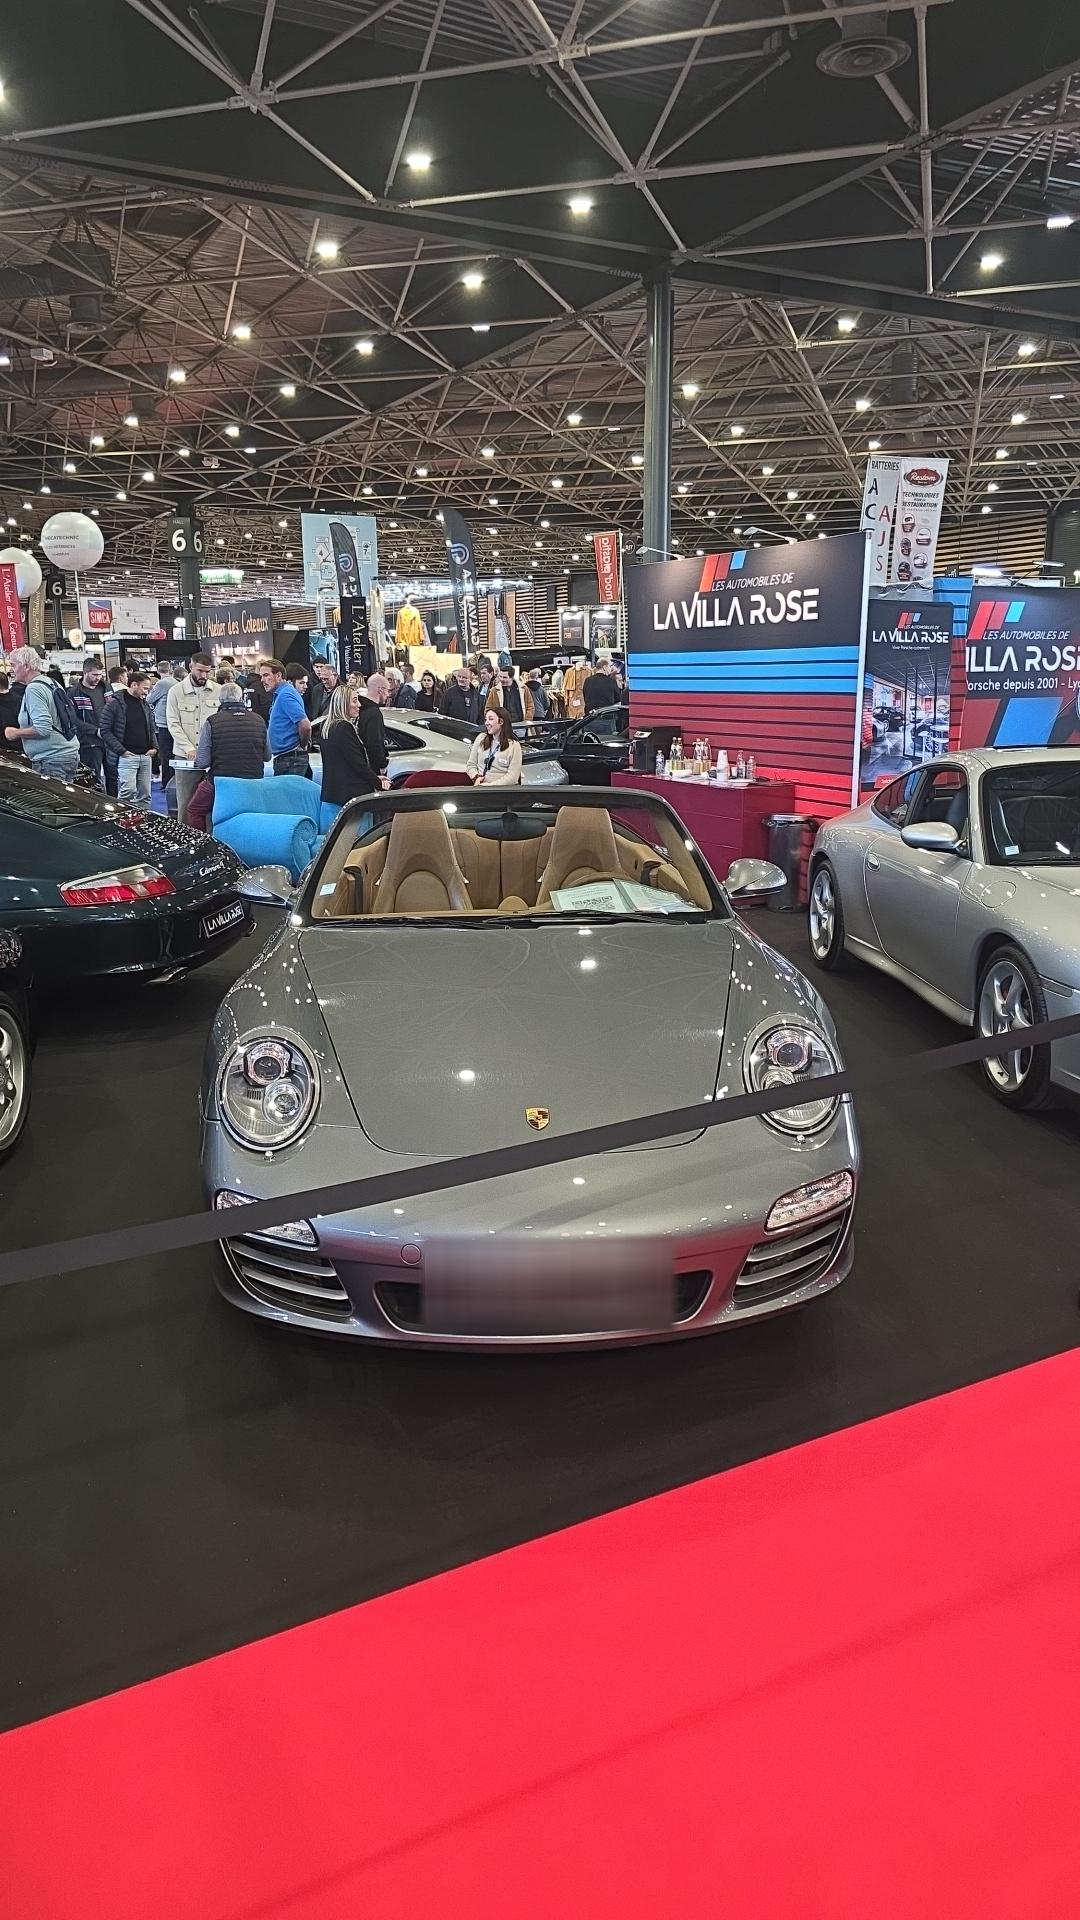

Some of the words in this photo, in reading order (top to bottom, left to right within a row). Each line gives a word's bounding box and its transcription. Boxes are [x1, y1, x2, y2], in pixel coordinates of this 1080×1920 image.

[871, 460, 900, 471] BATTERIES
[910, 472, 936, 481] Restom
[903, 491, 939, 499] TECHNOLOGIES
[171, 529, 187, 552] 6
[193, 530, 203, 553] 6
[52, 581, 63, 596] 6
[711, 580, 725, 592] LES
[726, 573, 780, 589] AUTOMOBILES
[781, 572, 795, 584] DE
[6, 605, 14, 620] des
[90, 611, 111, 624] SIMCA
[653, 602, 680, 631] LA
[681, 591, 745, 629] VILLA
[750, 588, 820, 625] ROSE
[200, 611, 226, 638] L'Atelier
[227, 611, 240, 636] des
[241, 610, 269, 634] Coteaux
[351, 604, 366, 665] L'Atelier
[872, 631, 887, 643] LA
[888, 628, 919, 643] VILLA
[921, 632, 949, 644] ROSE
[982, 630, 999, 640] LES
[999, 630, 1057, 640] AUTOMOBILES
[1057, 630, 1070, 640] DE
[967, 679, 1001, 691] orsche
[1003, 678, 1035, 693] depuis
[1037, 677, 1058, 689] 2001
[200, 864, 221, 877] Carrera
[207, 919, 219, 931] LA
[215, 912, 233, 926] VILLA
[230, 905, 242, 919] ROSE
